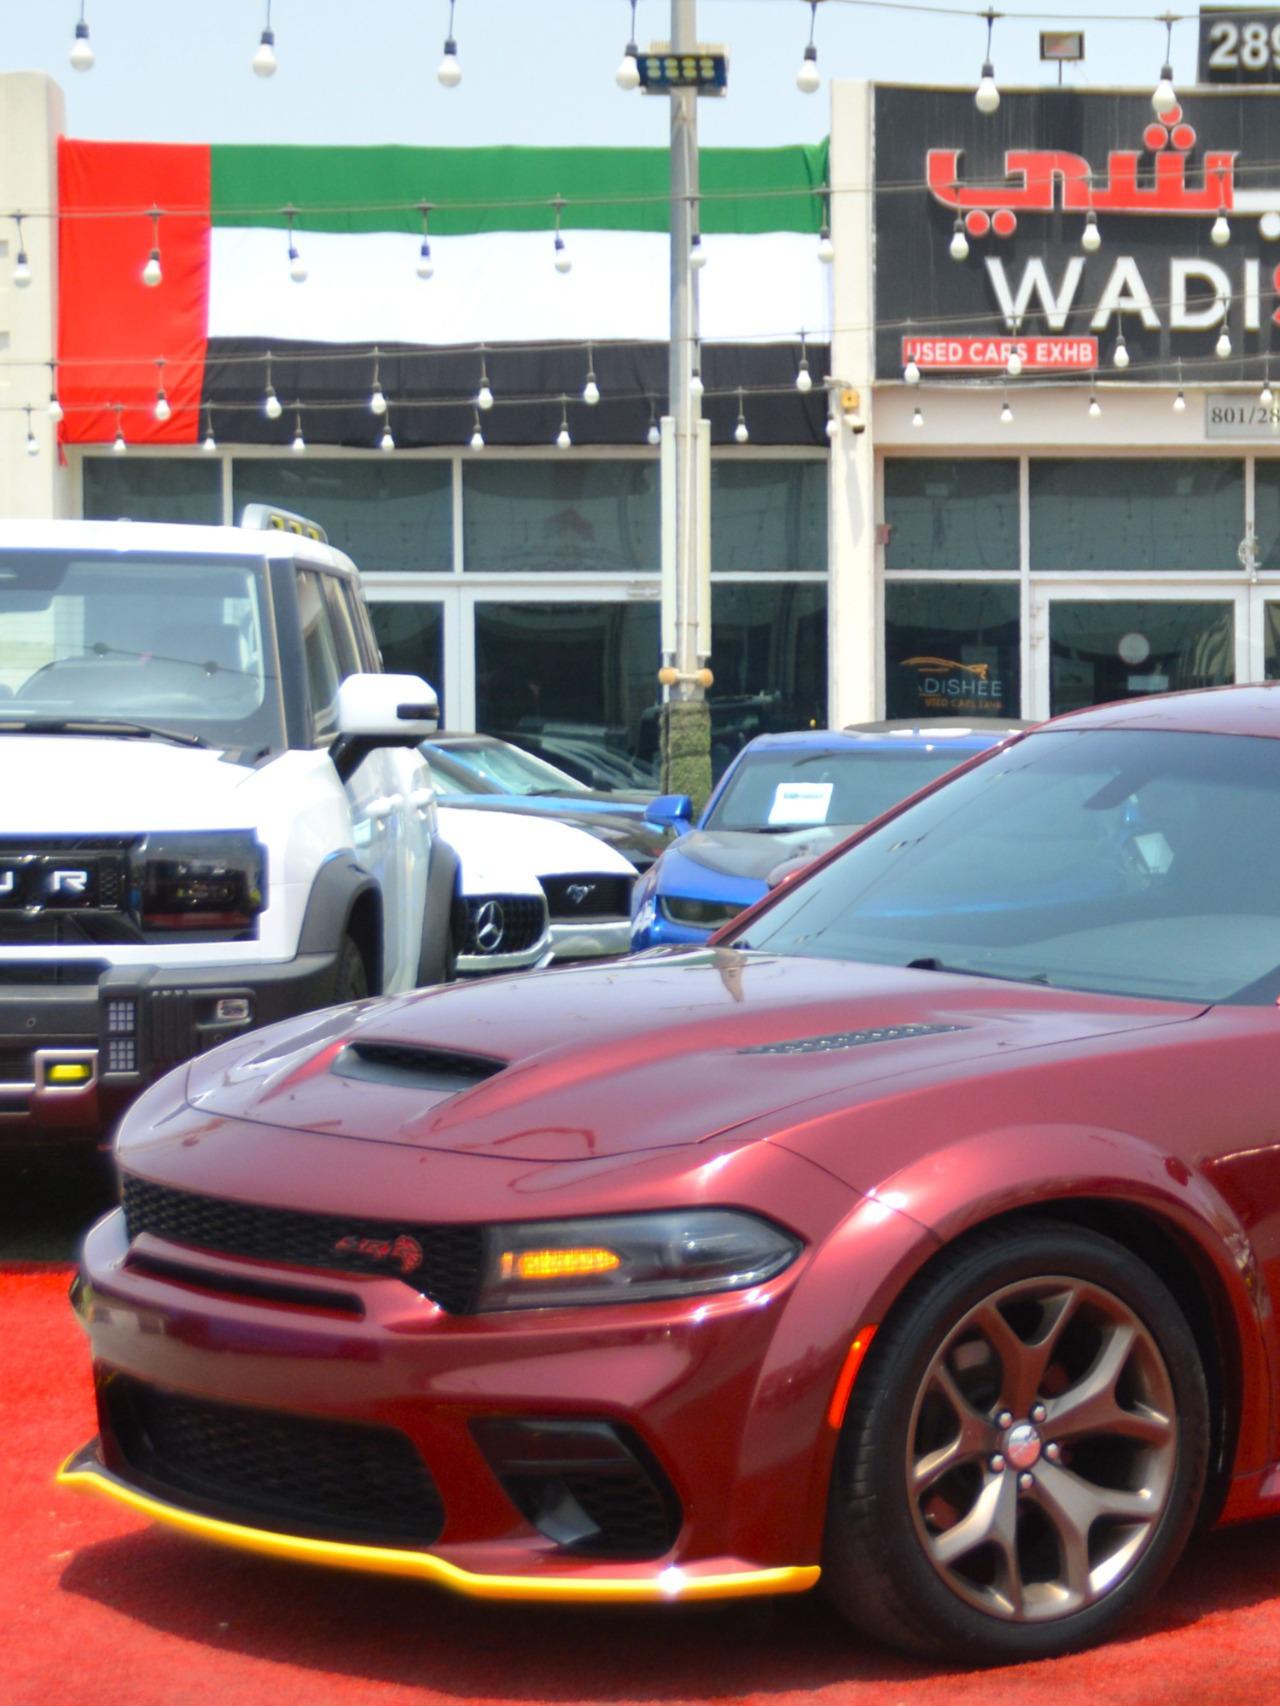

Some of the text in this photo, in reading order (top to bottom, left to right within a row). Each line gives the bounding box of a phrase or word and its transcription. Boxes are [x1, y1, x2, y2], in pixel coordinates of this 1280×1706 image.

[907, 342, 963, 362] USED
[1036, 342, 1094, 363] EXHB
[917, 677, 1003, 697] DISHEE
